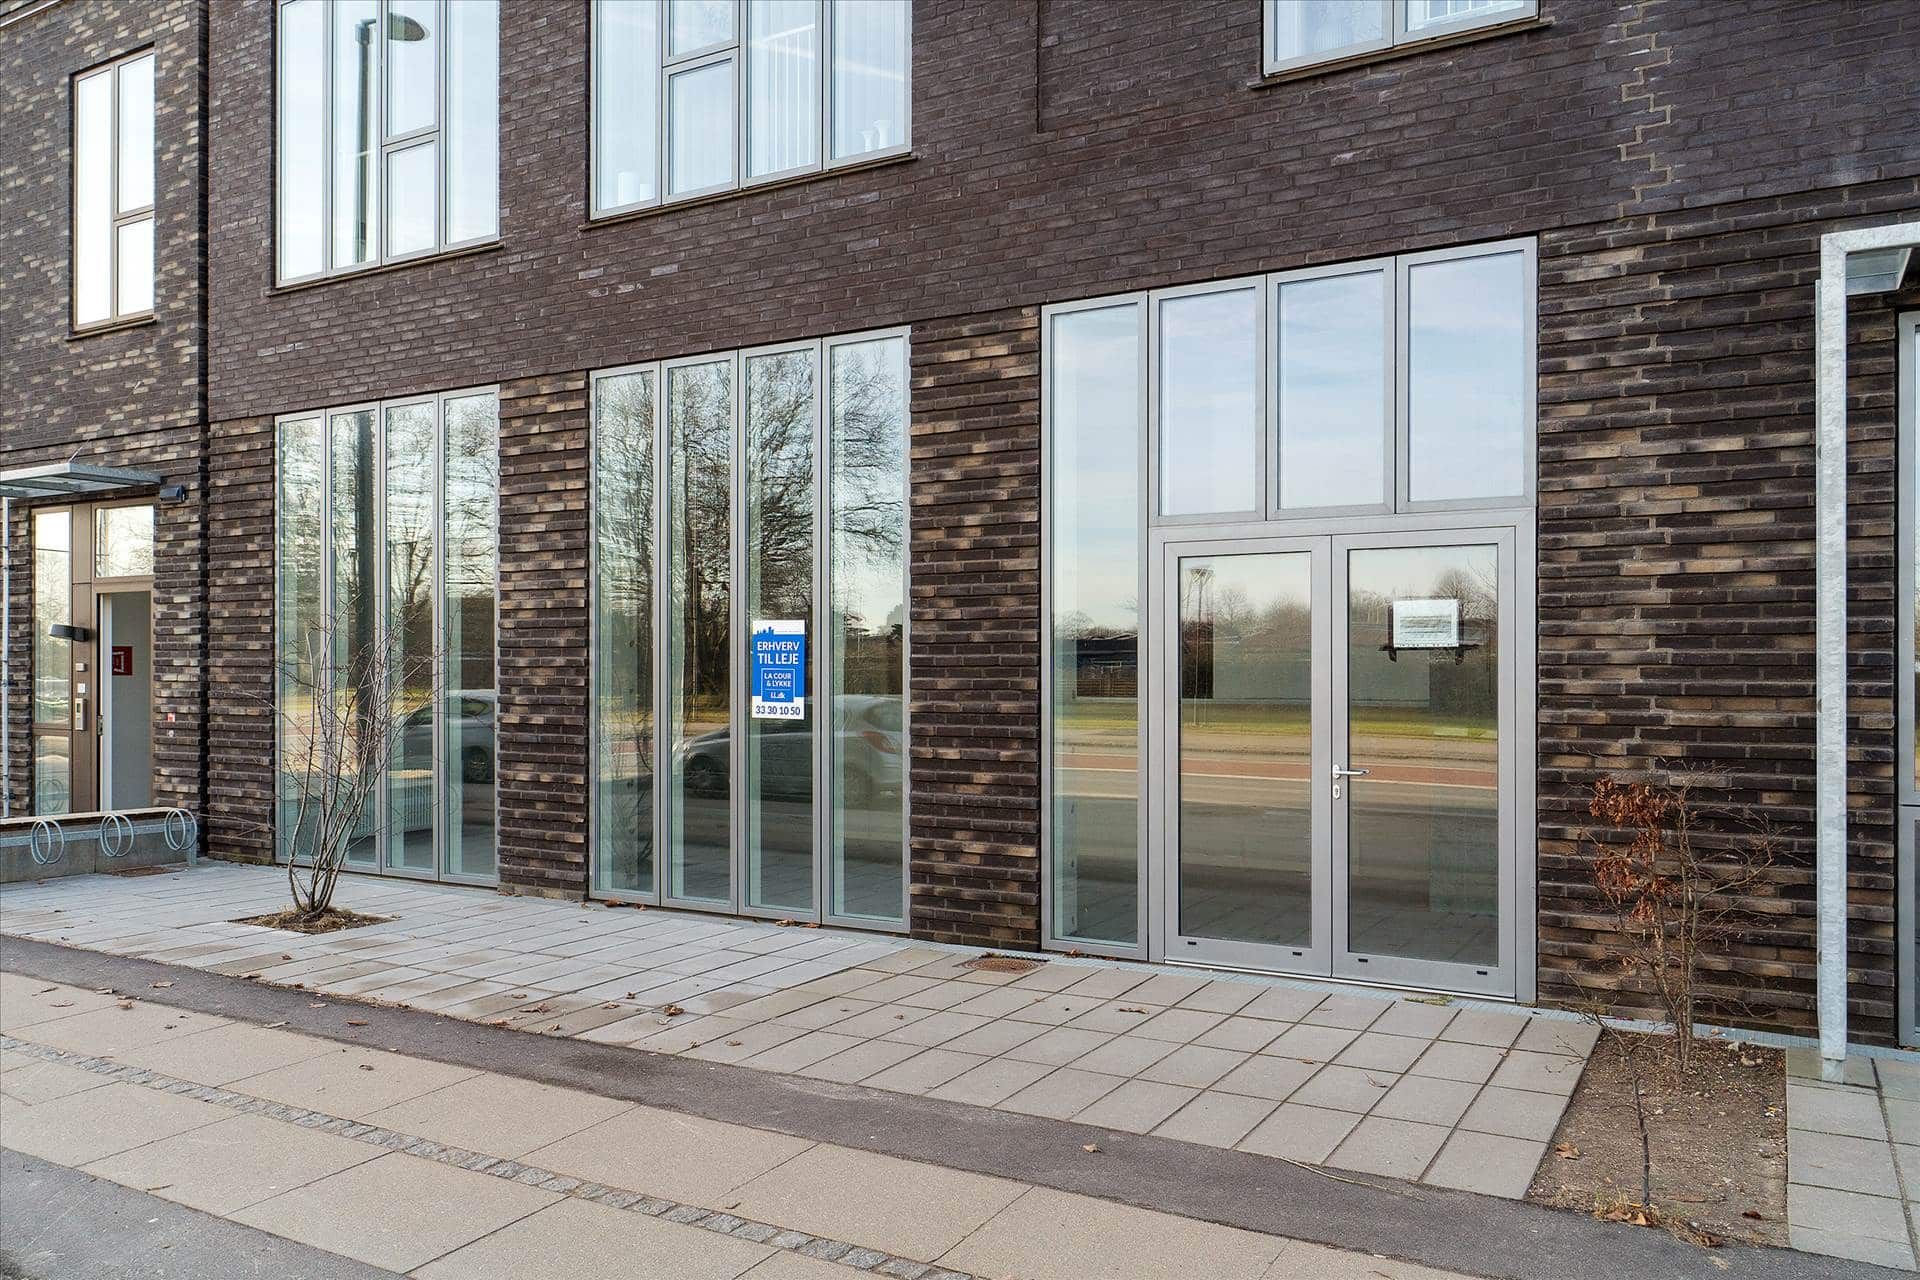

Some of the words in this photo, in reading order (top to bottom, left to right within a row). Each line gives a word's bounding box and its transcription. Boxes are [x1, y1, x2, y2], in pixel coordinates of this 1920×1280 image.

[757, 641, 800, 651] ERHVERV
[757, 653, 774, 665] TIL
[775, 653, 799, 665] LEJE
[773, 672, 792, 680] COUR
[756, 705, 766, 714] 33
[779, 706, 790, 715] 10
[790, 706, 801, 716] 50
